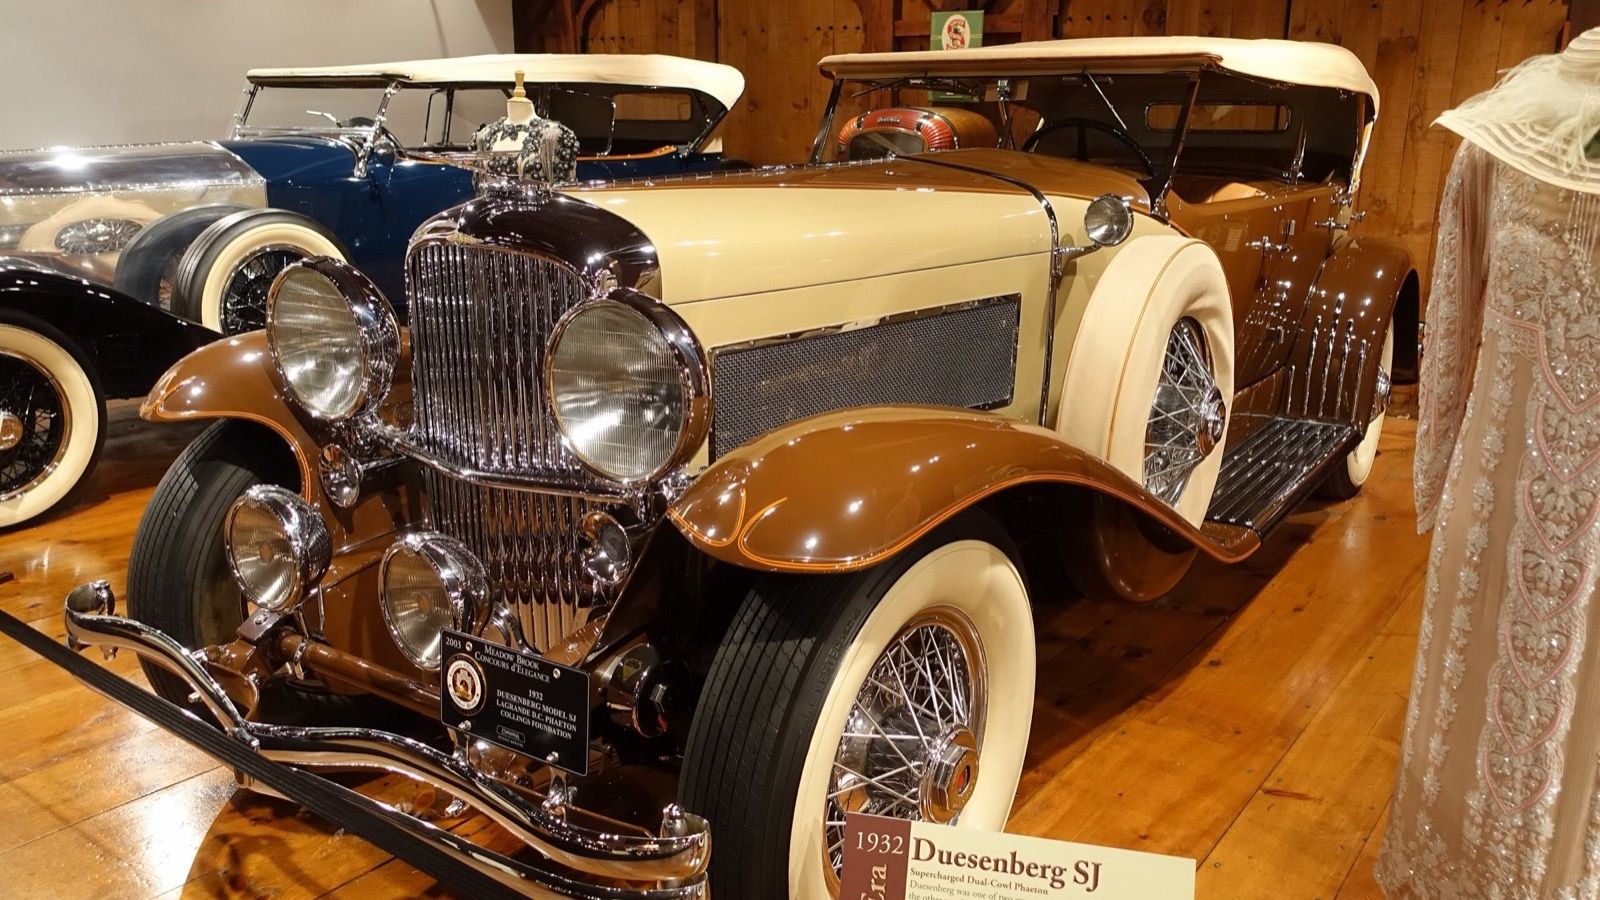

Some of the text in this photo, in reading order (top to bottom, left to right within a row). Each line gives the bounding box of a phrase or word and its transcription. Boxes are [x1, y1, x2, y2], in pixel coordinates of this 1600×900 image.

[446, 637, 461, 649] 2003
[474, 651, 551, 684] CONCOURS d'ELEGANCE
[484, 644, 540, 671] MEADOW BROOK
[496, 688, 577, 723] DUESENBERG MODEL SJ
[529, 689, 543, 701] 1932
[496, 698, 577, 733] LAGRANDE D.C. PHAETON
[500, 709, 531, 726] COLLINGS
[531, 719, 572, 740] FOUNDATION
[856, 831, 904, 855] 1932
[911, 836, 1103, 893] Duesenberg SJ
[909, 879, 955, 896] Duesenberg
[956, 888, 971, 896] was
[972, 891, 987, 899] one
[988, 891, 998, 900] of
[910, 867, 1049, 895] Supercharged Dual-Cowl Phaeton
[909, 891, 920, 900] the
